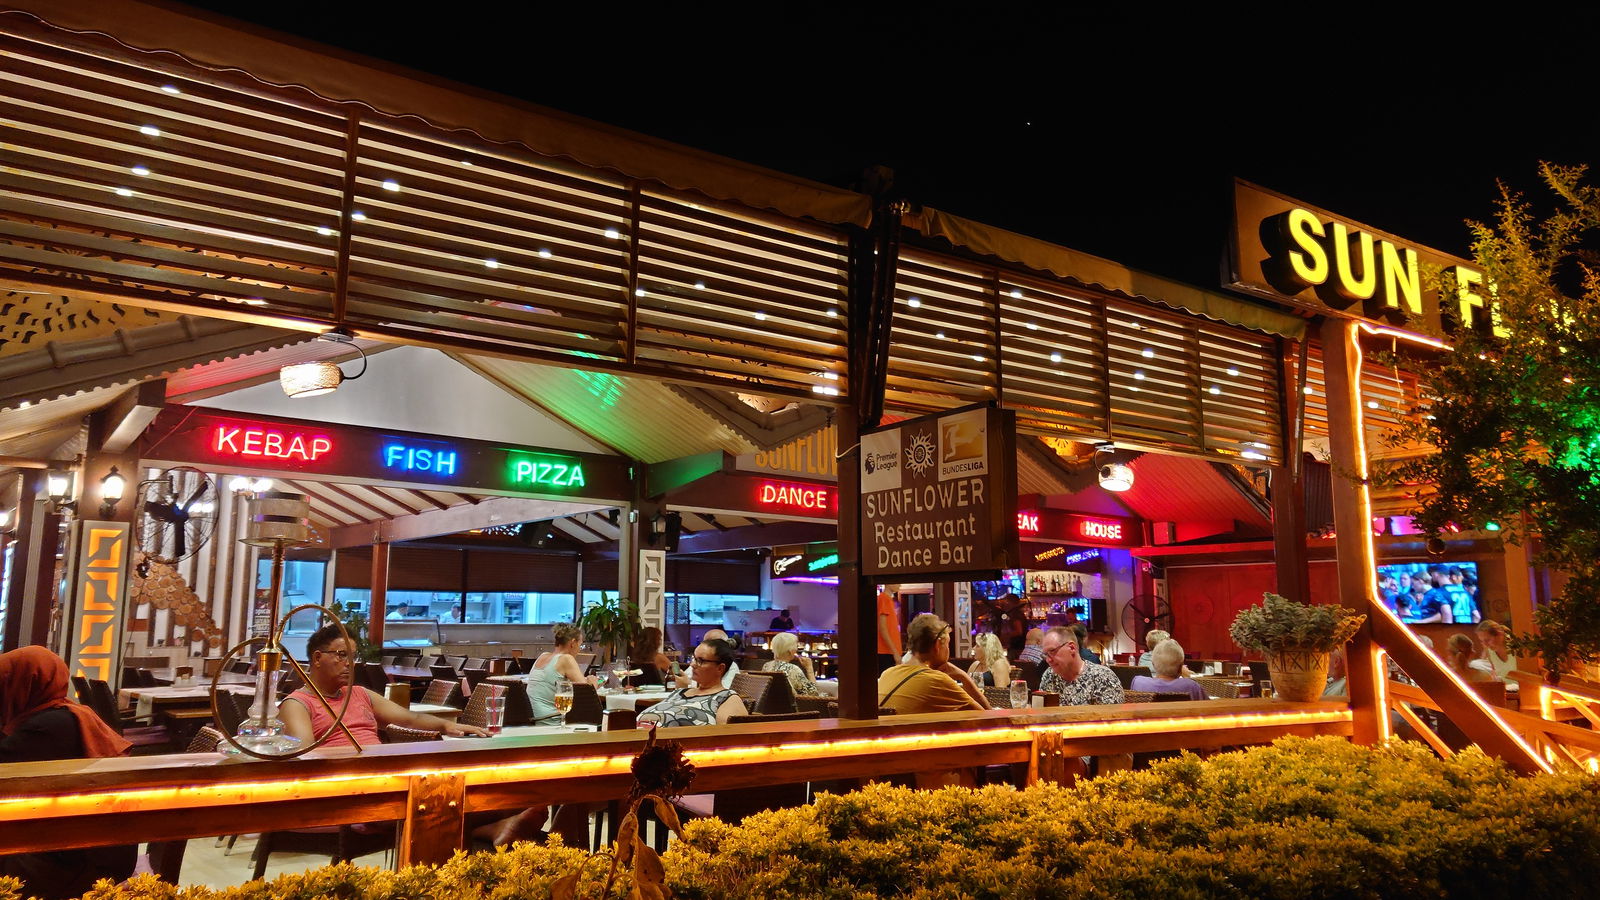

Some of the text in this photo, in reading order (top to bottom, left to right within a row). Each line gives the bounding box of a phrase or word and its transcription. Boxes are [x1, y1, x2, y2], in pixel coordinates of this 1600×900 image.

[1288, 208, 1423, 315] SUN
[217, 427, 330, 460] KEBAP
[876, 451, 898, 462] Premier
[387, 446, 456, 474] FISH
[876, 461, 898, 471] League
[942, 461, 984, 475] BUNDESLIGA
[517, 461, 585, 487] PIZZA
[762, 485, 828, 509] DANCE
[866, 478, 985, 519] SUNFLOWER
[874, 512, 976, 543] Restaurant
[1084, 521, 1122, 539] HOUSE
[877, 540, 973, 568] Dance Bar
[1451, 592, 1471, 616] 20
